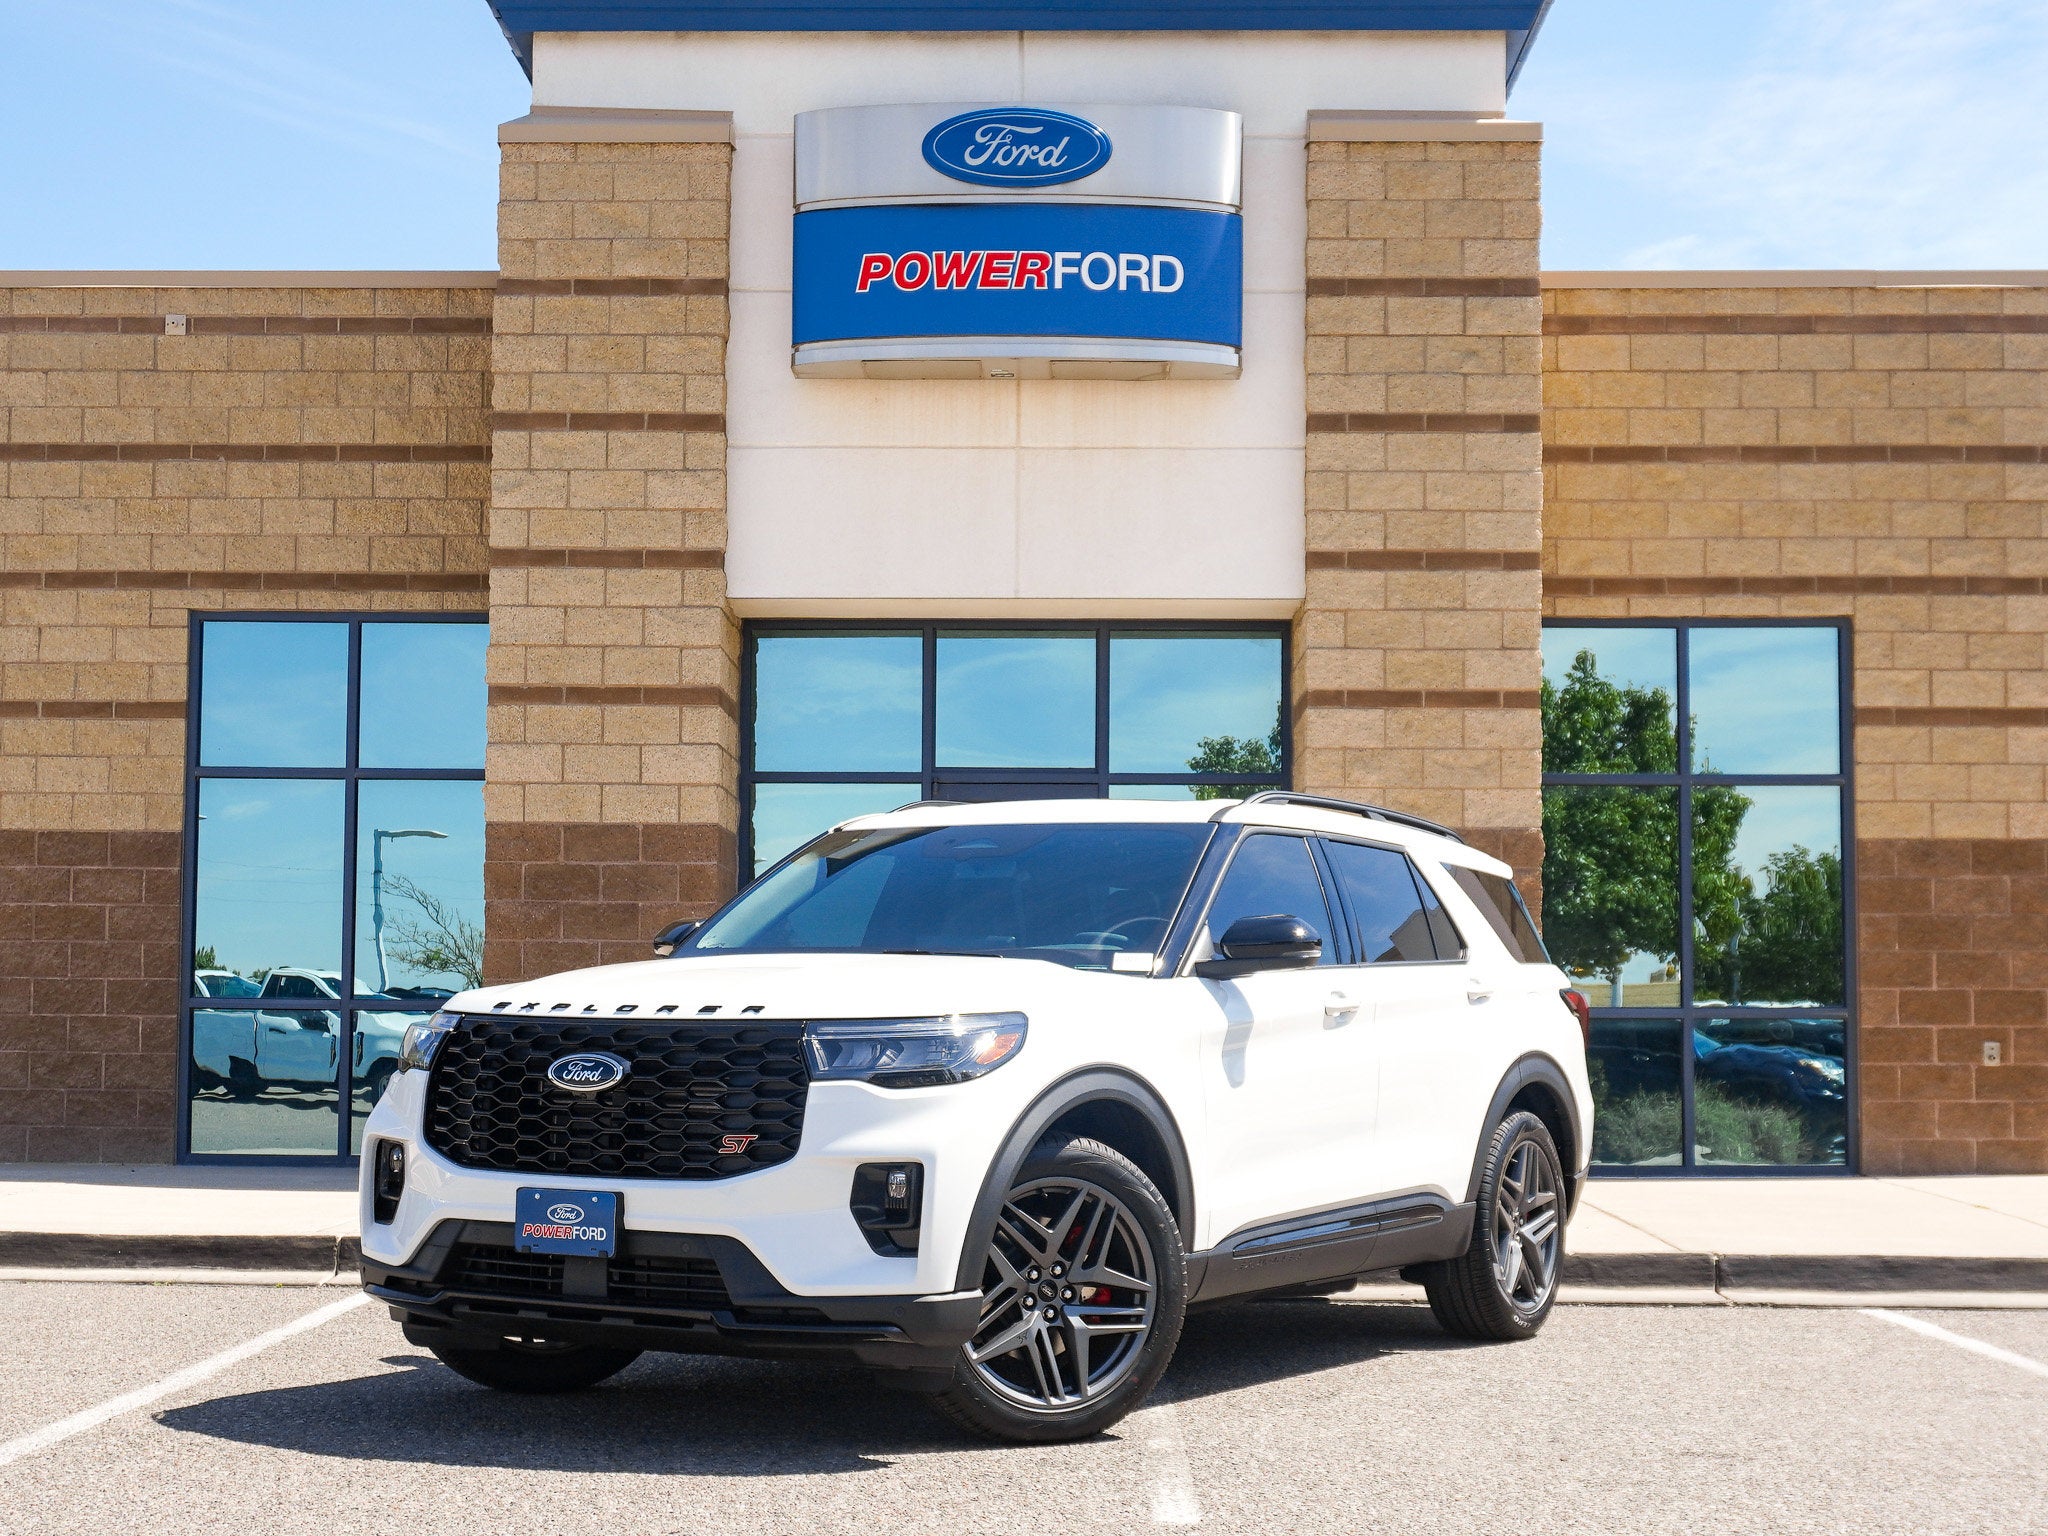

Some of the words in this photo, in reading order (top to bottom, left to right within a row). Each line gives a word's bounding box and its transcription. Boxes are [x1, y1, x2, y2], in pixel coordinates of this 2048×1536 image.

[963, 123, 1071, 168] Ford
[855, 250, 1185, 293] POWERFORD
[492, 1001, 766, 1013] EXPLORER
[562, 1060, 602, 1082] Ford
[718, 1134, 759, 1154] ST
[554, 1207, 577, 1220] Ford
[522, 1223, 607, 1241] POWERFORD
